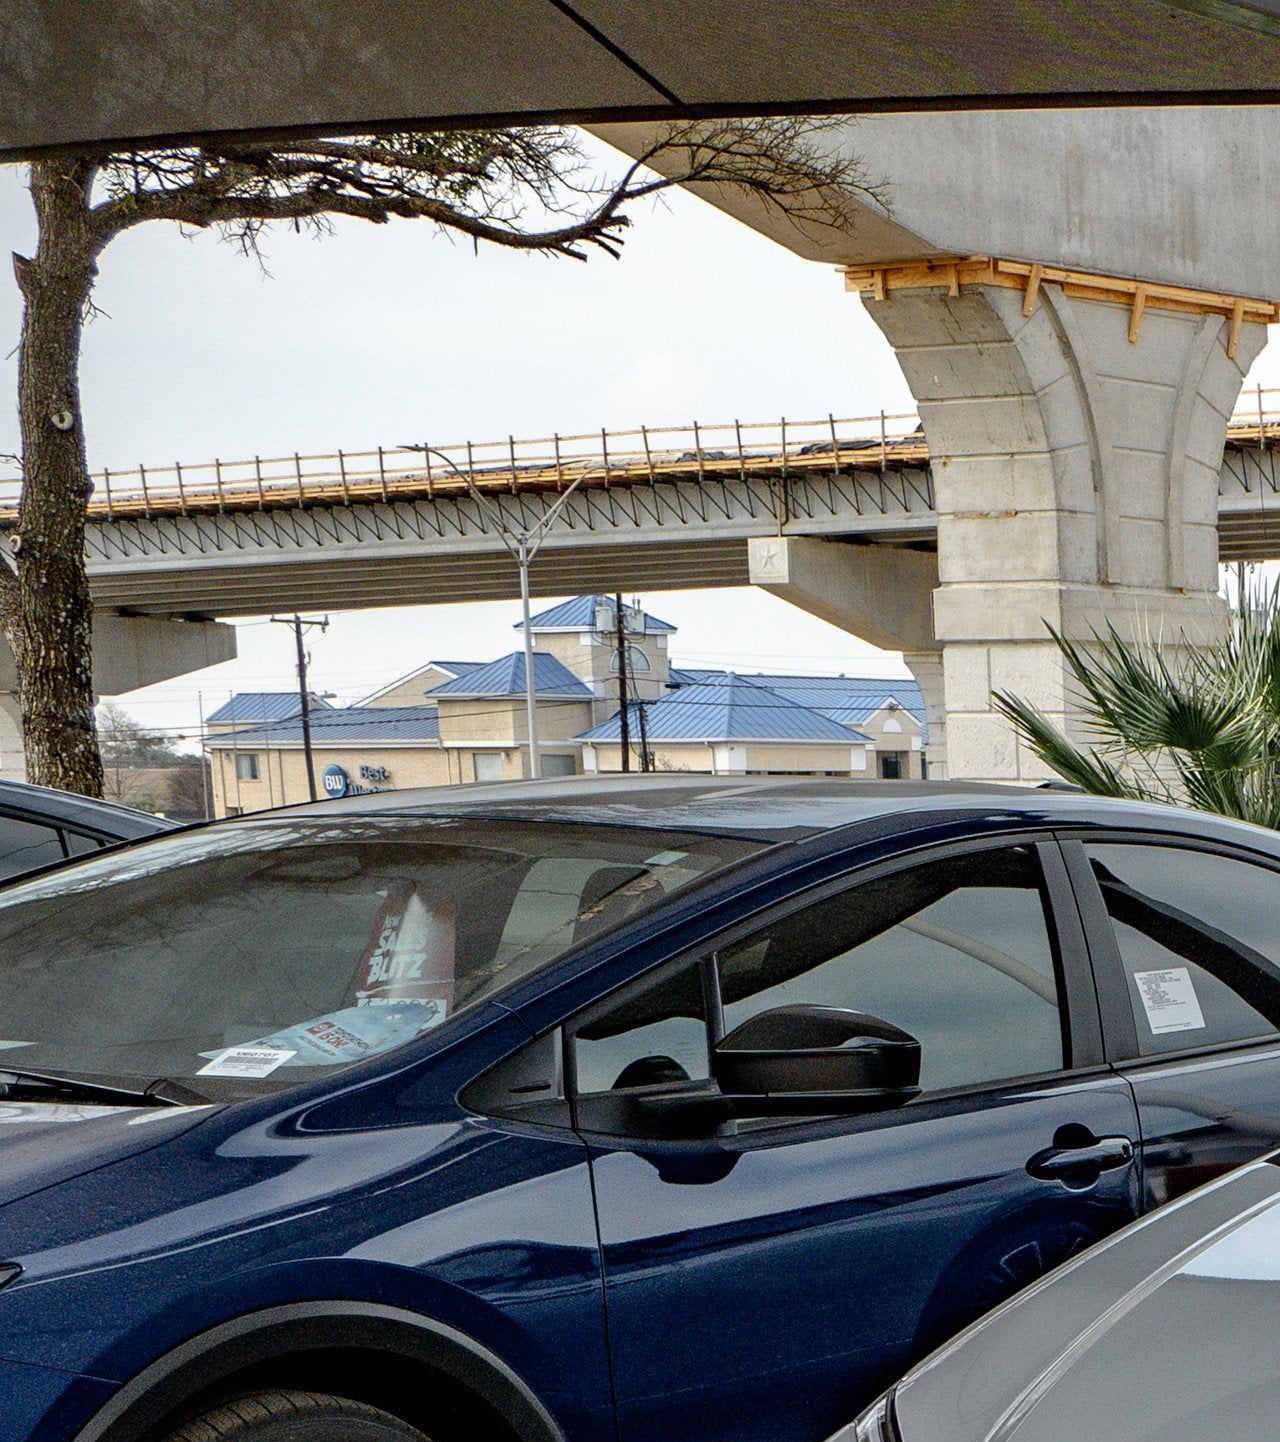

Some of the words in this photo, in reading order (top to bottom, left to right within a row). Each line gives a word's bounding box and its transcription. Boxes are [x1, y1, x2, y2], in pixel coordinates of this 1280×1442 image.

[360, 765, 387, 781] Best
[324, 775, 343, 790] BW
[367, 952, 428, 985] BLITZ
